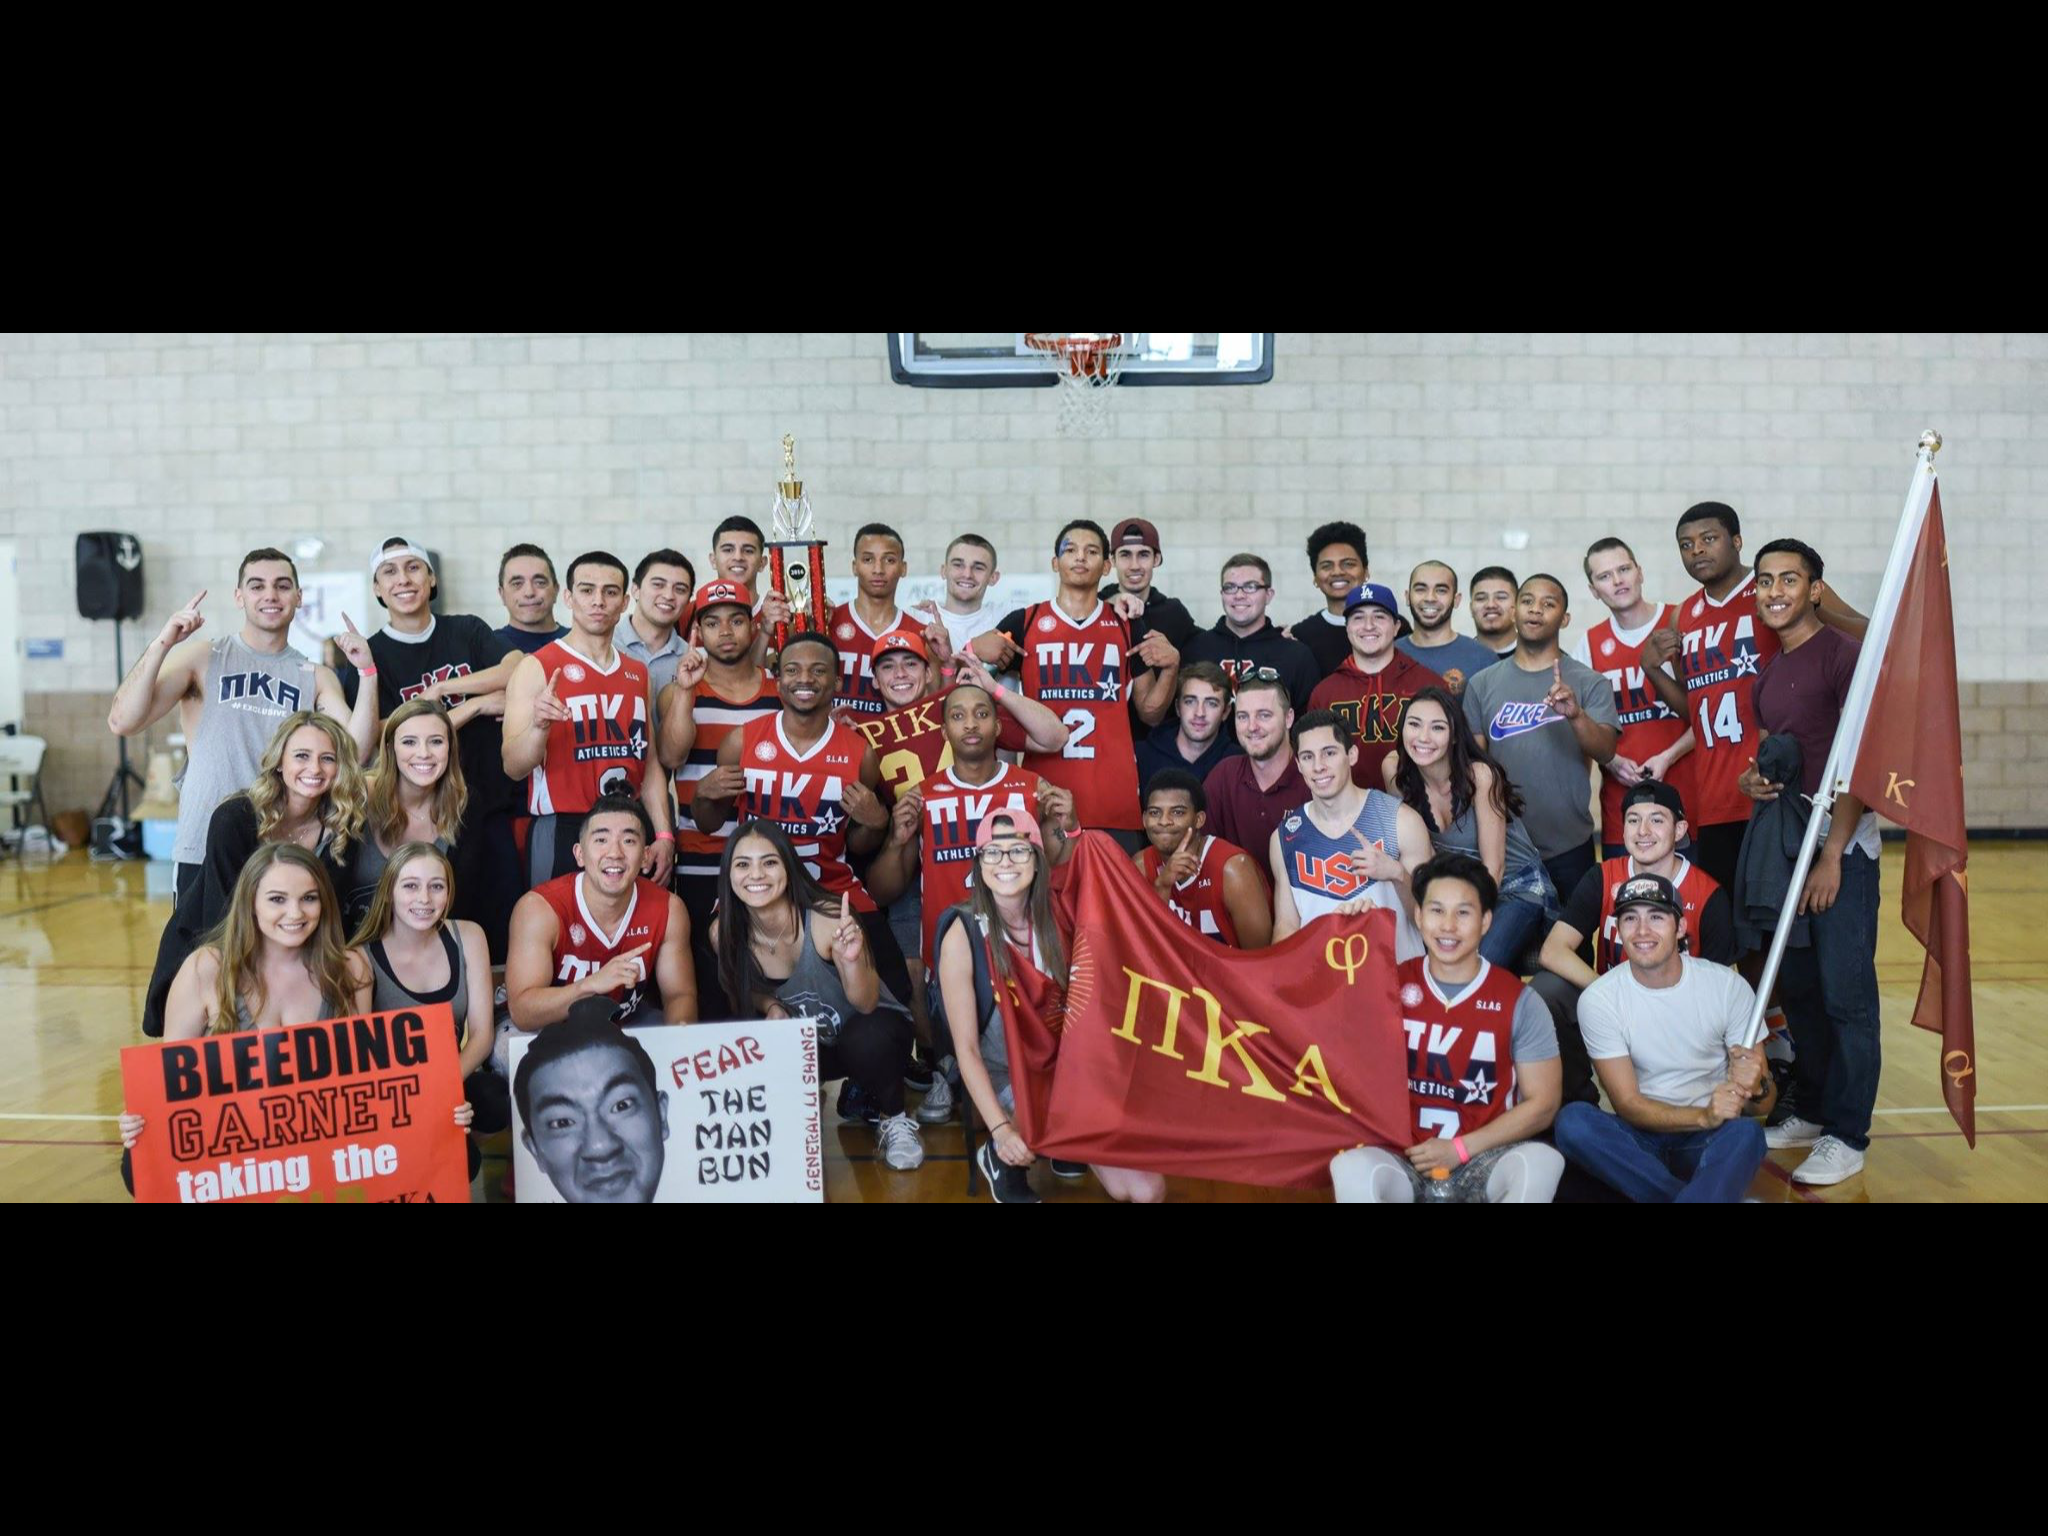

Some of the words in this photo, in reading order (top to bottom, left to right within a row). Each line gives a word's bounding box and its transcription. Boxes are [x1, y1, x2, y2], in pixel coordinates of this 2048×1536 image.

[1041, 688, 1095, 699] ATHLETICS
[1687, 669, 1729, 690] ATHLETICS
[857, 696, 946, 749] PIK
[1062, 707, 1096, 759] 2
[1499, 702, 1549, 725] PIKE
[1699, 691, 1743, 748] 14
[161, 1012, 429, 1102] BLEEDING
[671, 1036, 765, 1089] FEAR
[800, 1027, 817, 1085] SHANG
[168, 1074, 420, 1162] GARNET
[700, 1085, 767, 1116] THE
[695, 1119, 771, 1150] MAN
[804, 1112, 821, 1191] GENERAL
[176, 1154, 310, 1203] taking
[332, 1144, 398, 1183] the
[698, 1151, 770, 1185] BUN
